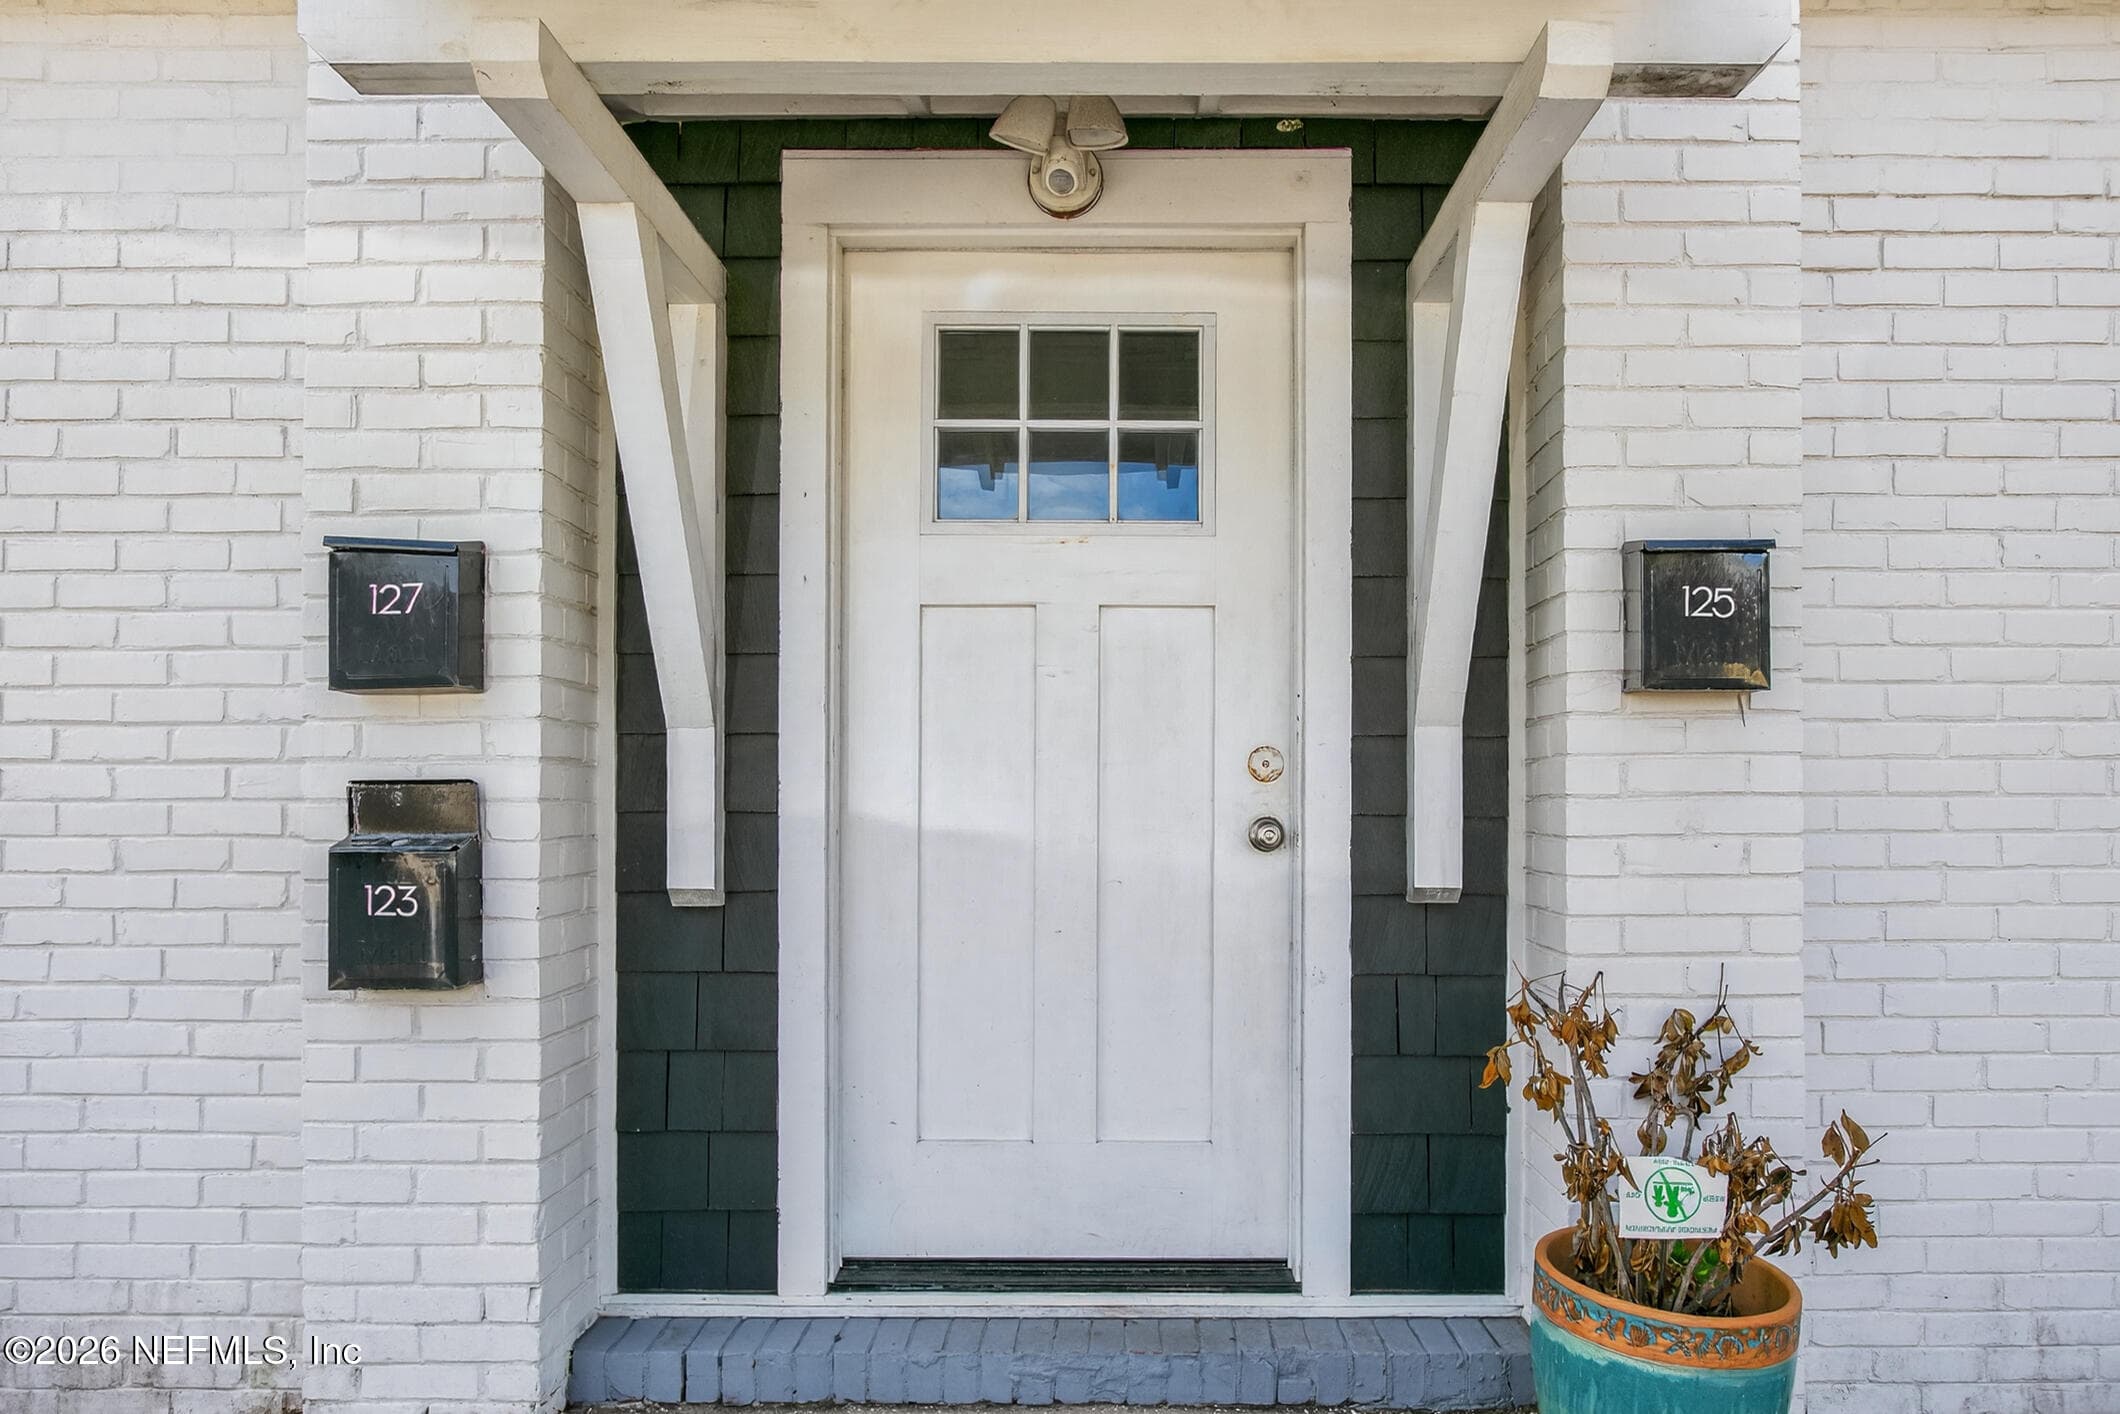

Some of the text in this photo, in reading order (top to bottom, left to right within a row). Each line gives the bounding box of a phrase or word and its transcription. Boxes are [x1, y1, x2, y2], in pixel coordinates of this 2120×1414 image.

[369, 582, 424, 615] 127
[1682, 585, 1735, 618] 125
[364, 884, 419, 917] 123
